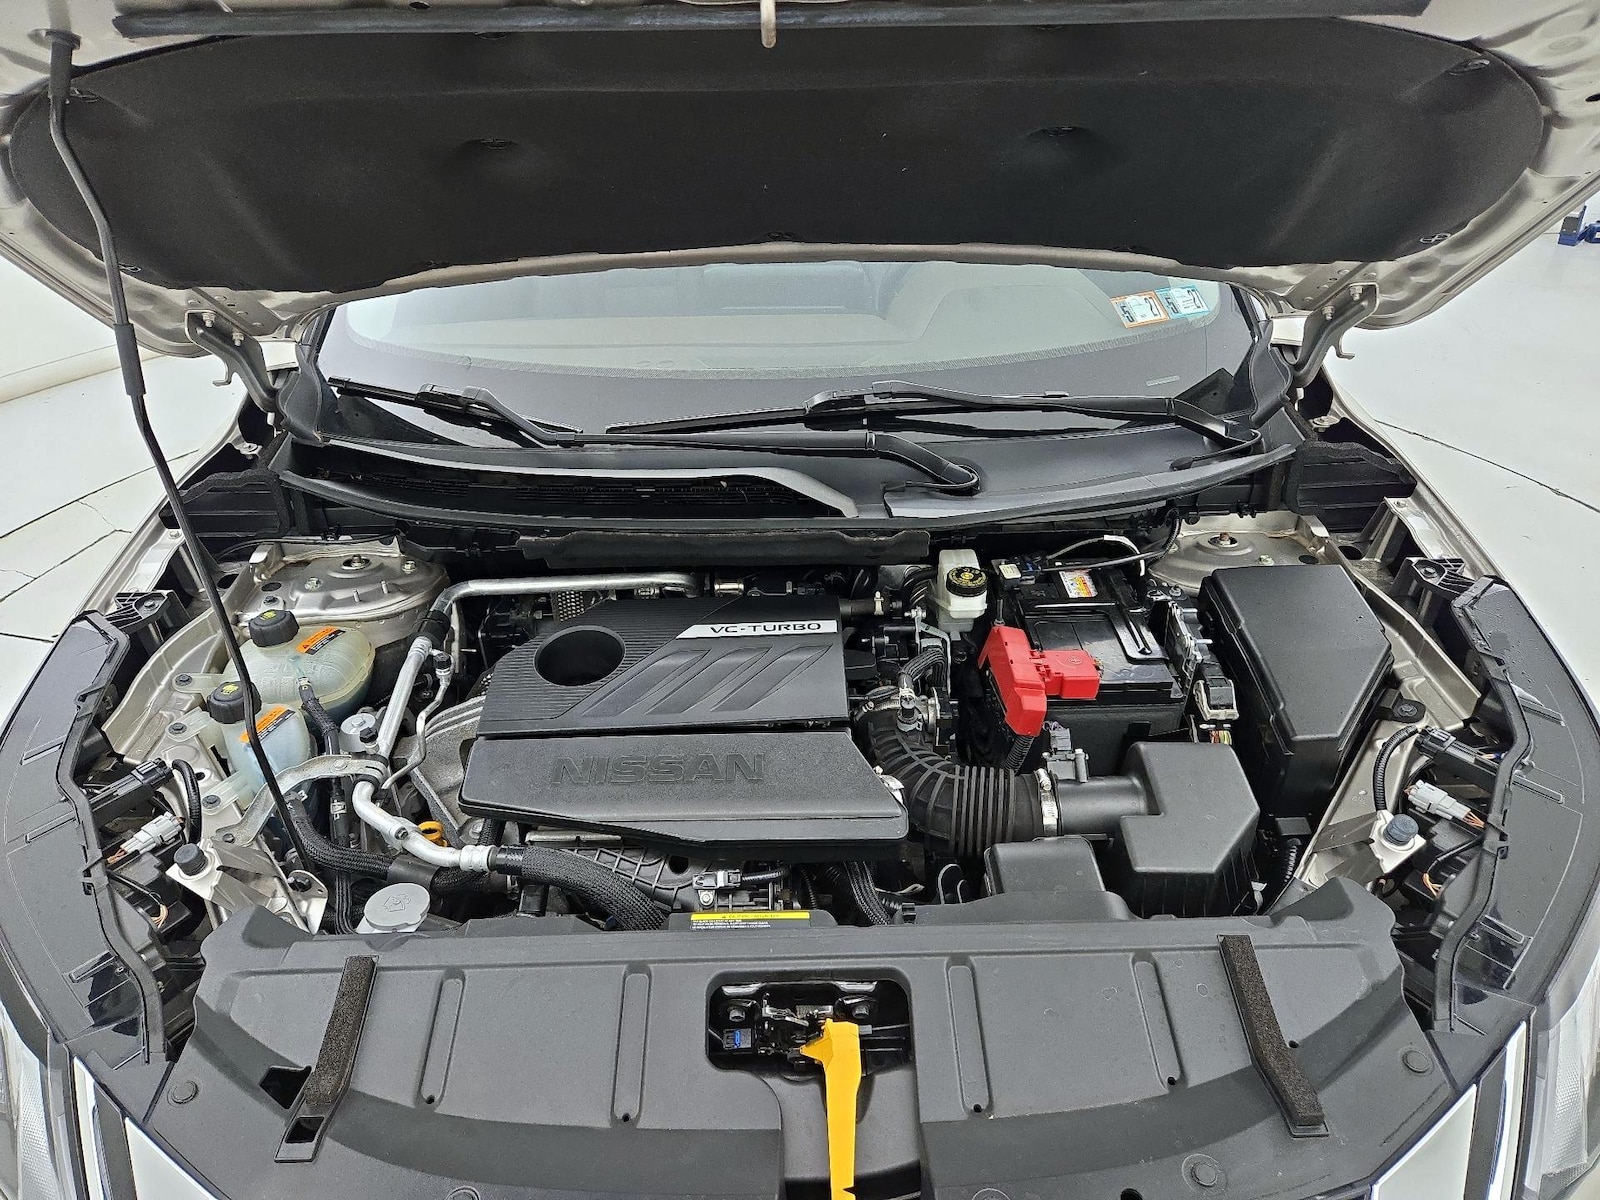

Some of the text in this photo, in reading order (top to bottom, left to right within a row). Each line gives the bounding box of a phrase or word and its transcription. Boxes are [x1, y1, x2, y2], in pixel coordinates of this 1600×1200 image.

[1120, 305, 1135, 323] 5
[1165, 297, 1179, 314] 5
[710, 623, 821, 633] VC-TURBO
[551, 753, 765, 784] NISSAN
